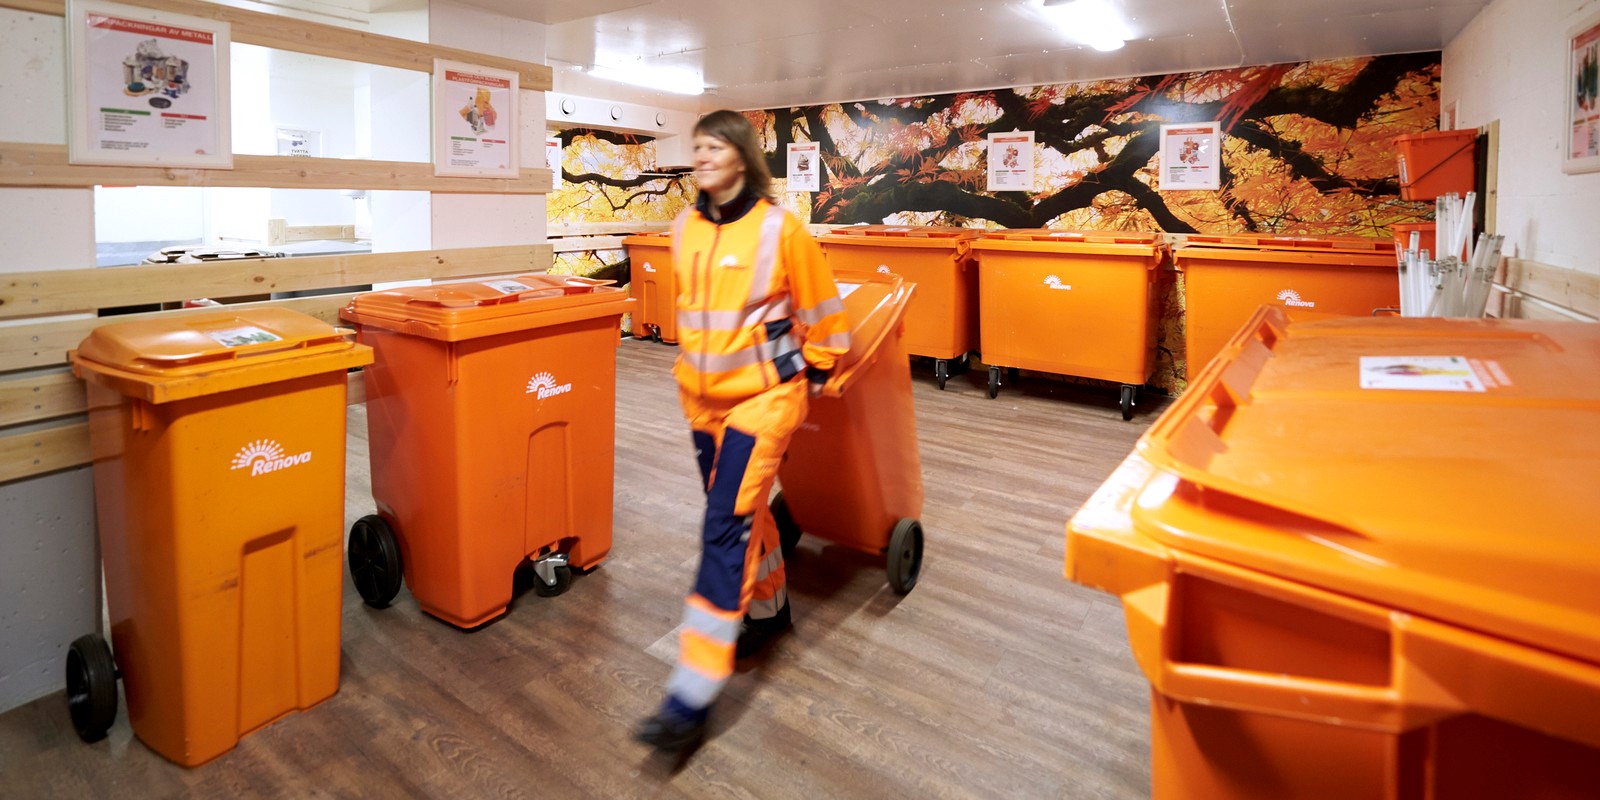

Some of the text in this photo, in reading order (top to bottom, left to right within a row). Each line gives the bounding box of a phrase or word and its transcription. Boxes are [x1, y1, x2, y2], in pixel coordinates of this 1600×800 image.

[181, 31, 212, 41] METALL
[1285, 298, 1315, 307] Renova
[537, 383, 572, 400] Renova
[251, 451, 312, 477] Renova
